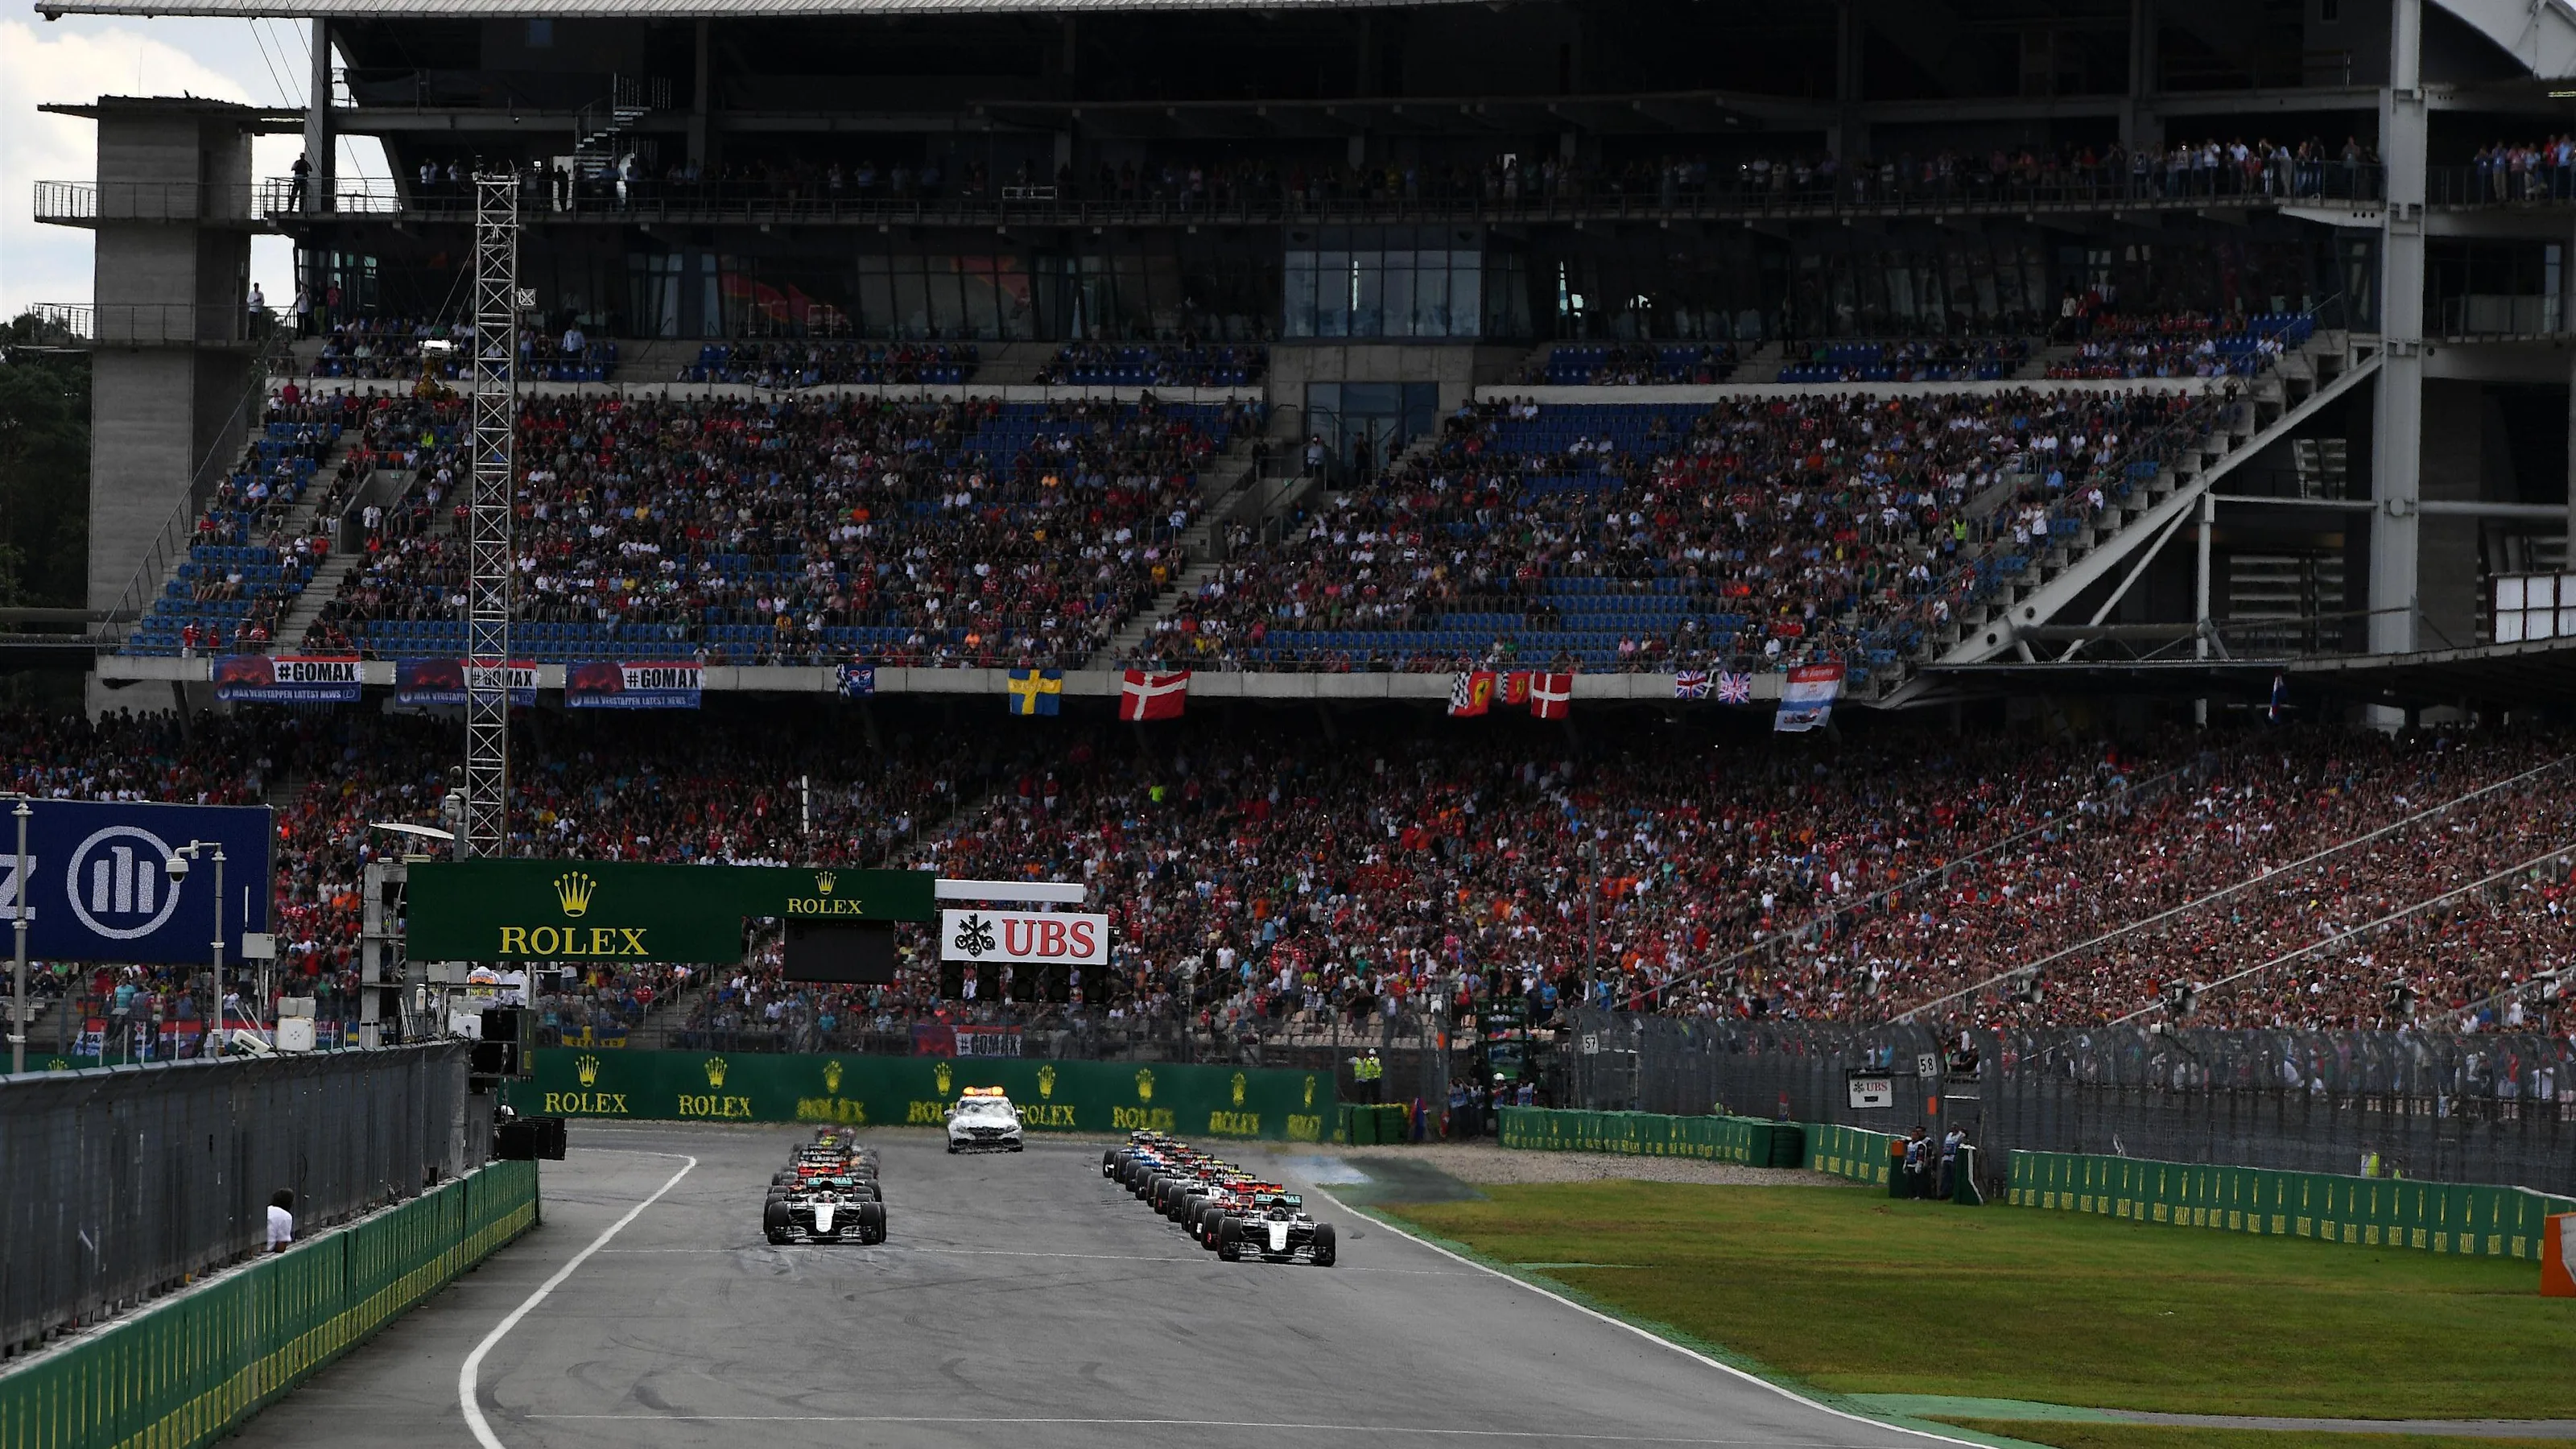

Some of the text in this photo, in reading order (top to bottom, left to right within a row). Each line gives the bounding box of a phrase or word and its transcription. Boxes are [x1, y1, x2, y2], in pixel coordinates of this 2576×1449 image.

[278, 663, 355, 681] #GOMAX
[626, 668, 698, 688] #GOMAX
[250, 690, 294, 699] VERSTAPPEN
[295, 690, 320, 699] LATEST
[320, 690, 341, 699] NEWS
[642, 696, 666, 706] LATEST
[667, 696, 687, 705] NEWS
[787, 898, 864, 915] ROLEX
[498, 927, 650, 956] ROLEX
[1001, 919, 1096, 958] UBS
[1585, 1037, 1596, 1049] 57
[1920, 1058, 1934, 1073] 58
[1866, 1081, 1888, 1092] UBS
[543, 1092, 629, 1113] ROLEX
[678, 1094, 753, 1117] ROLEX
